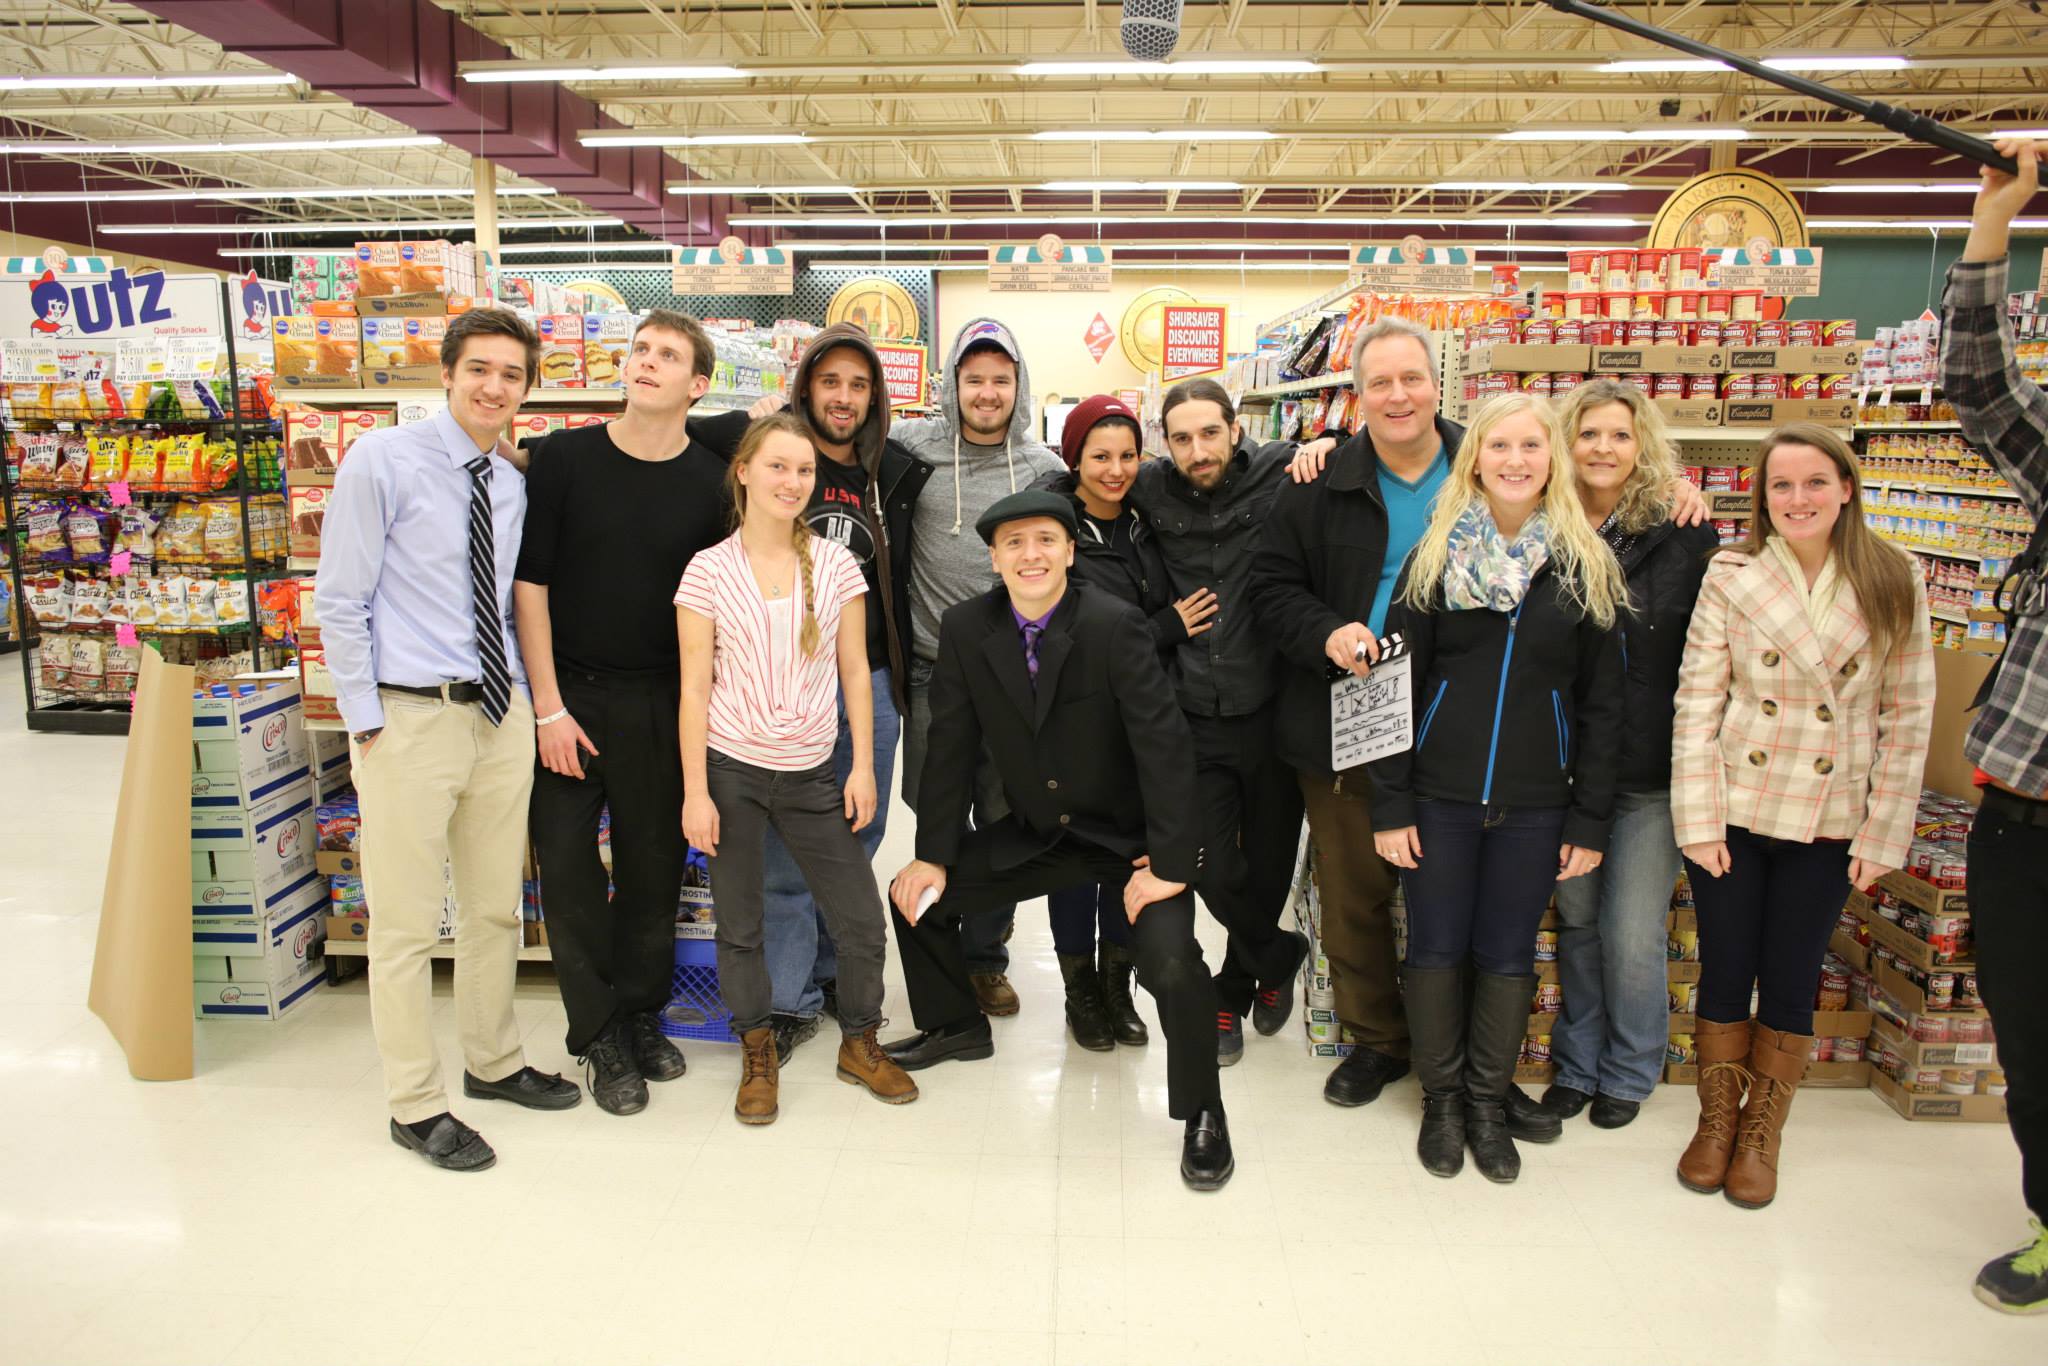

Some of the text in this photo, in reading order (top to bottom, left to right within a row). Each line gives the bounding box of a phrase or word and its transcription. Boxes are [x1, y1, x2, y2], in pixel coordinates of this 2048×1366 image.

[374, 247, 396, 257] Quick
[417, 247, 441, 257] Quick
[557, 320, 580, 329] Quick
[603, 320, 626, 329] Quick
[1168, 311, 1220, 328] SHURSAVER
[291, 321, 313, 331] Quick
[334, 321, 357, 330] Quick
[380, 322, 402, 331] Quick
[422, 321, 445, 330] Quick
[153, 326, 208, 337] Quality Snacks
[555, 327, 580, 337] Bread
[600, 327, 627, 337] Bread
[1527, 327, 1551, 337] CHUNKY
[1557, 327, 1581, 337] CHUNKY
[1168, 329, 1220, 346] DISCOUNTS
[878, 351, 919, 367] HURSAVER
[1167, 347, 1219, 363] EVERYWHERE
[1600, 352, 1641, 368] Campbell's
[1732, 352, 1774, 368] Campbell's
[1657, 383, 1681, 391] CHUNKY
[1692, 383, 1715, 391] CHUNKY
[1730, 405, 1770, 421] Campbell's
[27, 445, 55, 459] Wavy
[1706, 474, 1731, 483] CHUNKY
[823, 487, 861, 511] USA
[106, 660, 129, 671] Hand
[265, 719, 287, 748] Crisco
[321, 821, 338, 833] Moist
[279, 824, 299, 854] Crisco
[204, 889, 224, 901] Crisco
[341, 889, 366, 900] Funf
[438, 927, 452, 937] AY
[296, 922, 318, 954] Crisco
[1666, 939, 1686, 955] NKY
[1823, 980, 1848, 990] CHUNKY
[1666, 1043, 1688, 1057] NKY
